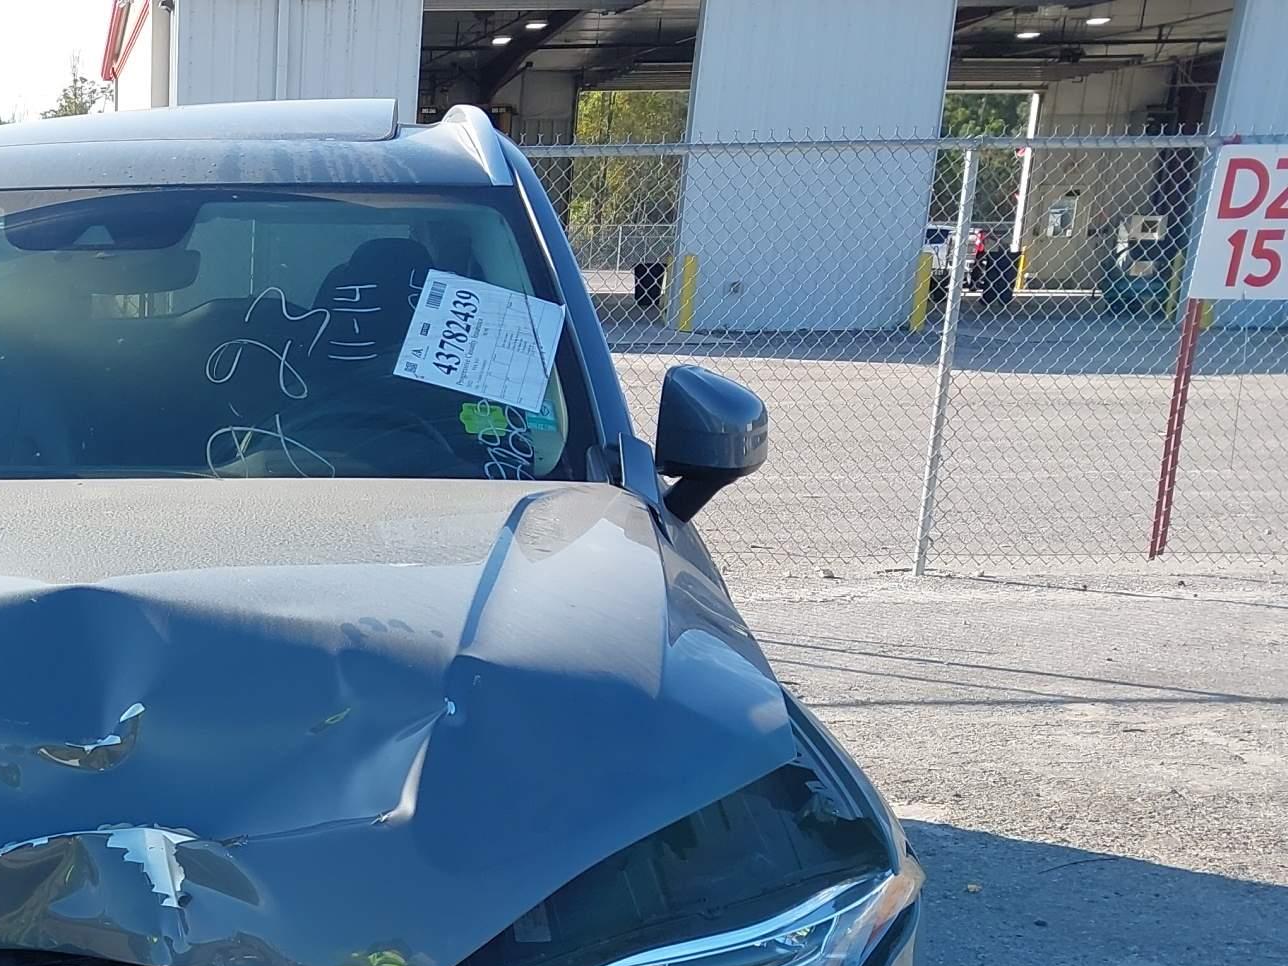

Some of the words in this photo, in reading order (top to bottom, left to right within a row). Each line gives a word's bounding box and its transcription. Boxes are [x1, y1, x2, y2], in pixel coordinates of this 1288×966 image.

[1225, 229, 1286, 287] 15
[328, 284, 382, 360] 11-14
[432, 289, 479, 374] 43782439
